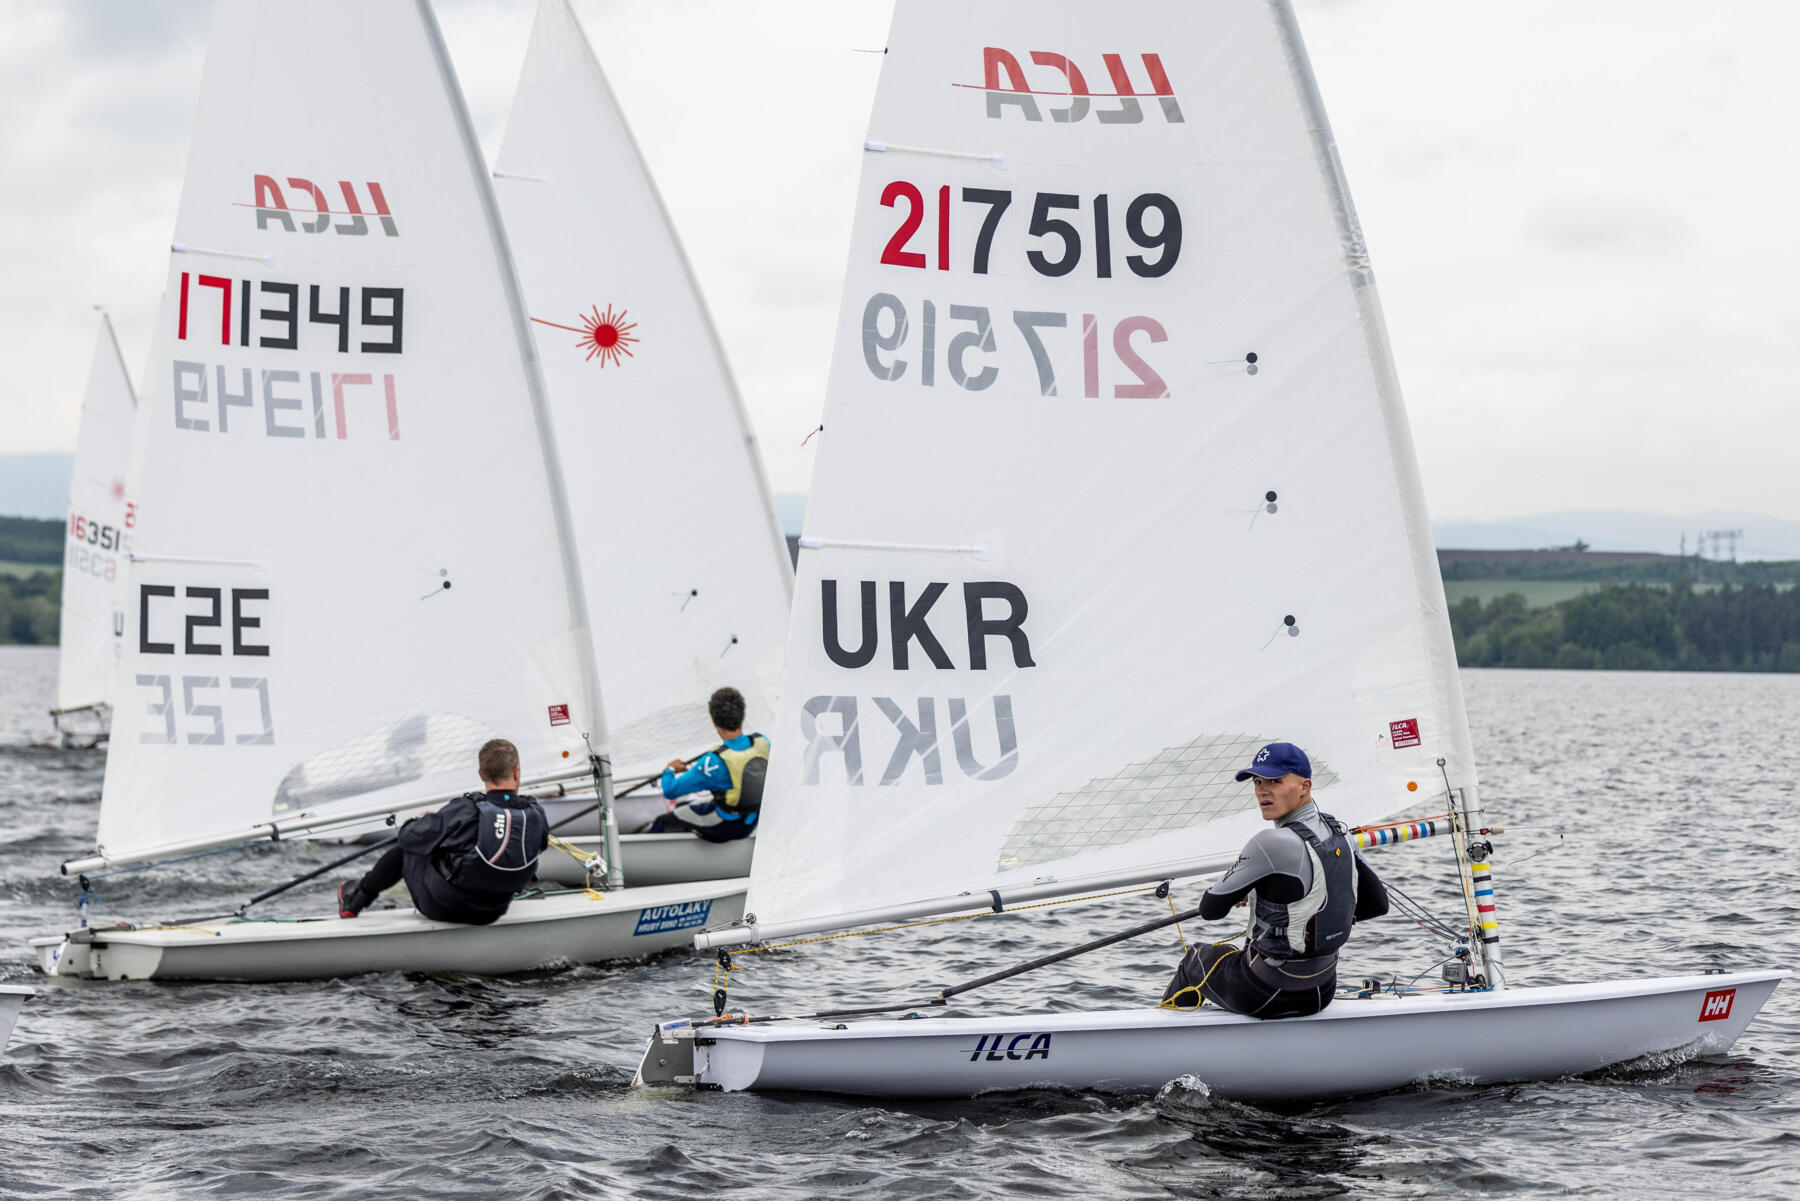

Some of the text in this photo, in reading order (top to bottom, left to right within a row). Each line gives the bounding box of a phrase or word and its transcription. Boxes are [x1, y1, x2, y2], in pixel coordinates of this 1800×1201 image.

[880, 180, 1183, 279] 217519
[178, 272, 404, 354] 171349
[821, 580, 1036, 670] UKR
[641, 901, 710, 921] AUTOLAKY
[969, 1033, 1051, 1061] ILCA
